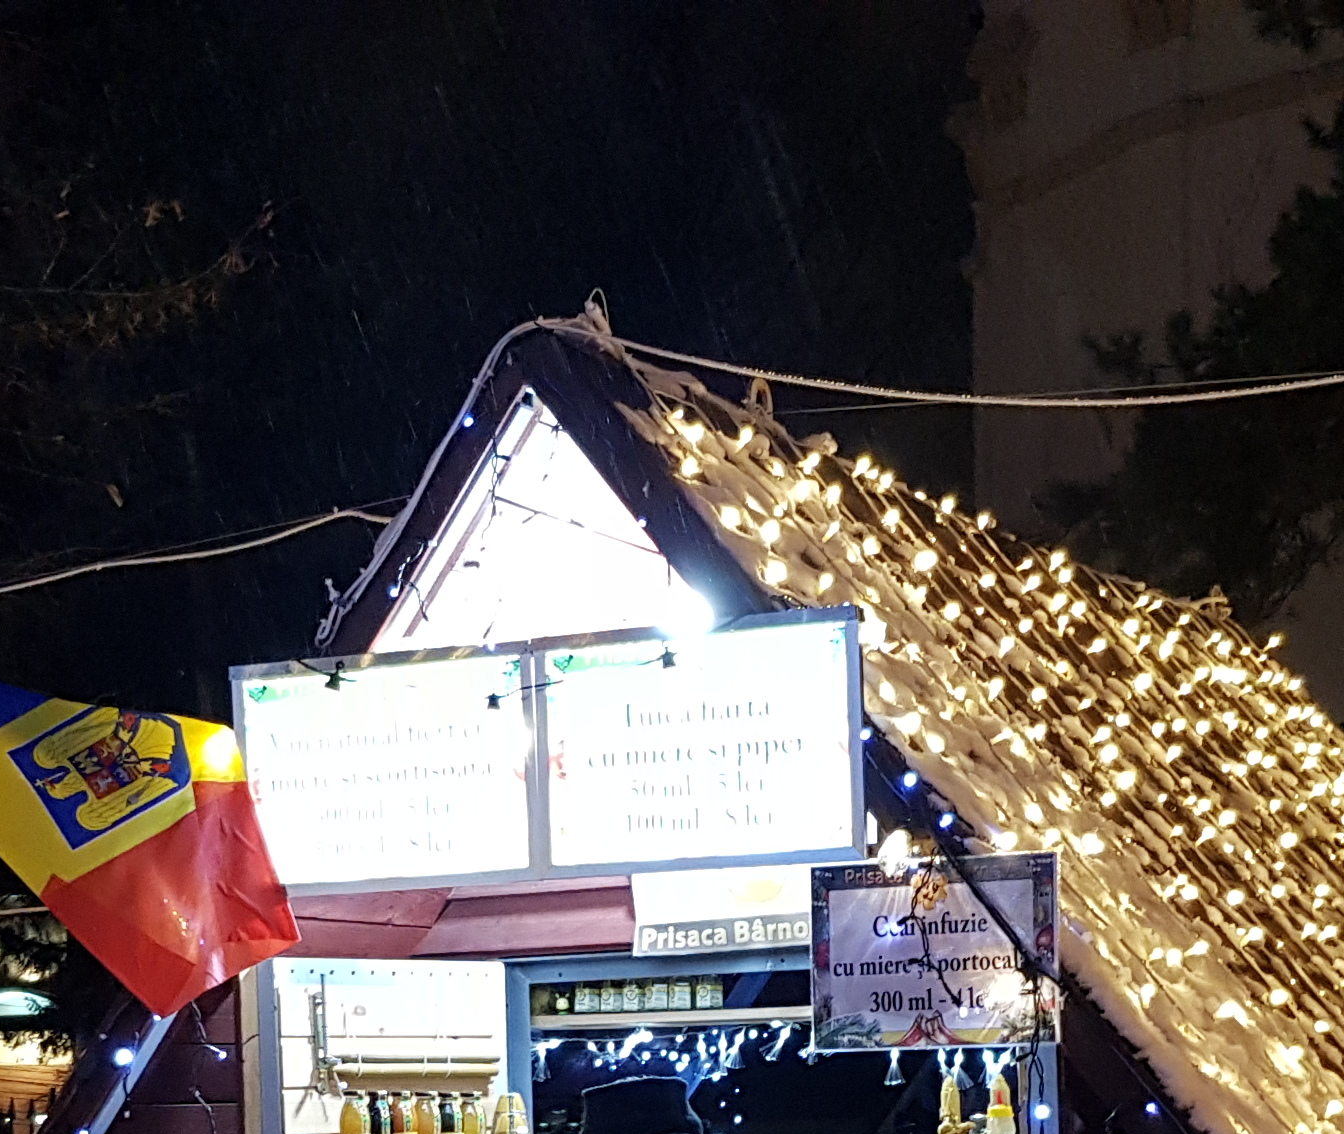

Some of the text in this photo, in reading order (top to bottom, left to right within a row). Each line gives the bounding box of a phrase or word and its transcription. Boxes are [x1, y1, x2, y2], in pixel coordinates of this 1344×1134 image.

[736, 734, 805, 767] piper
[641, 918, 810, 952] Prisaca Bârno
[921, 912, 988, 937] infuzie
[833, 961, 854, 977] cu
[859, 955, 912, 976] miere
[937, 945, 1029, 981] portocal
[869, 990, 904, 1014] 300
[907, 988, 933, 1010] ml
